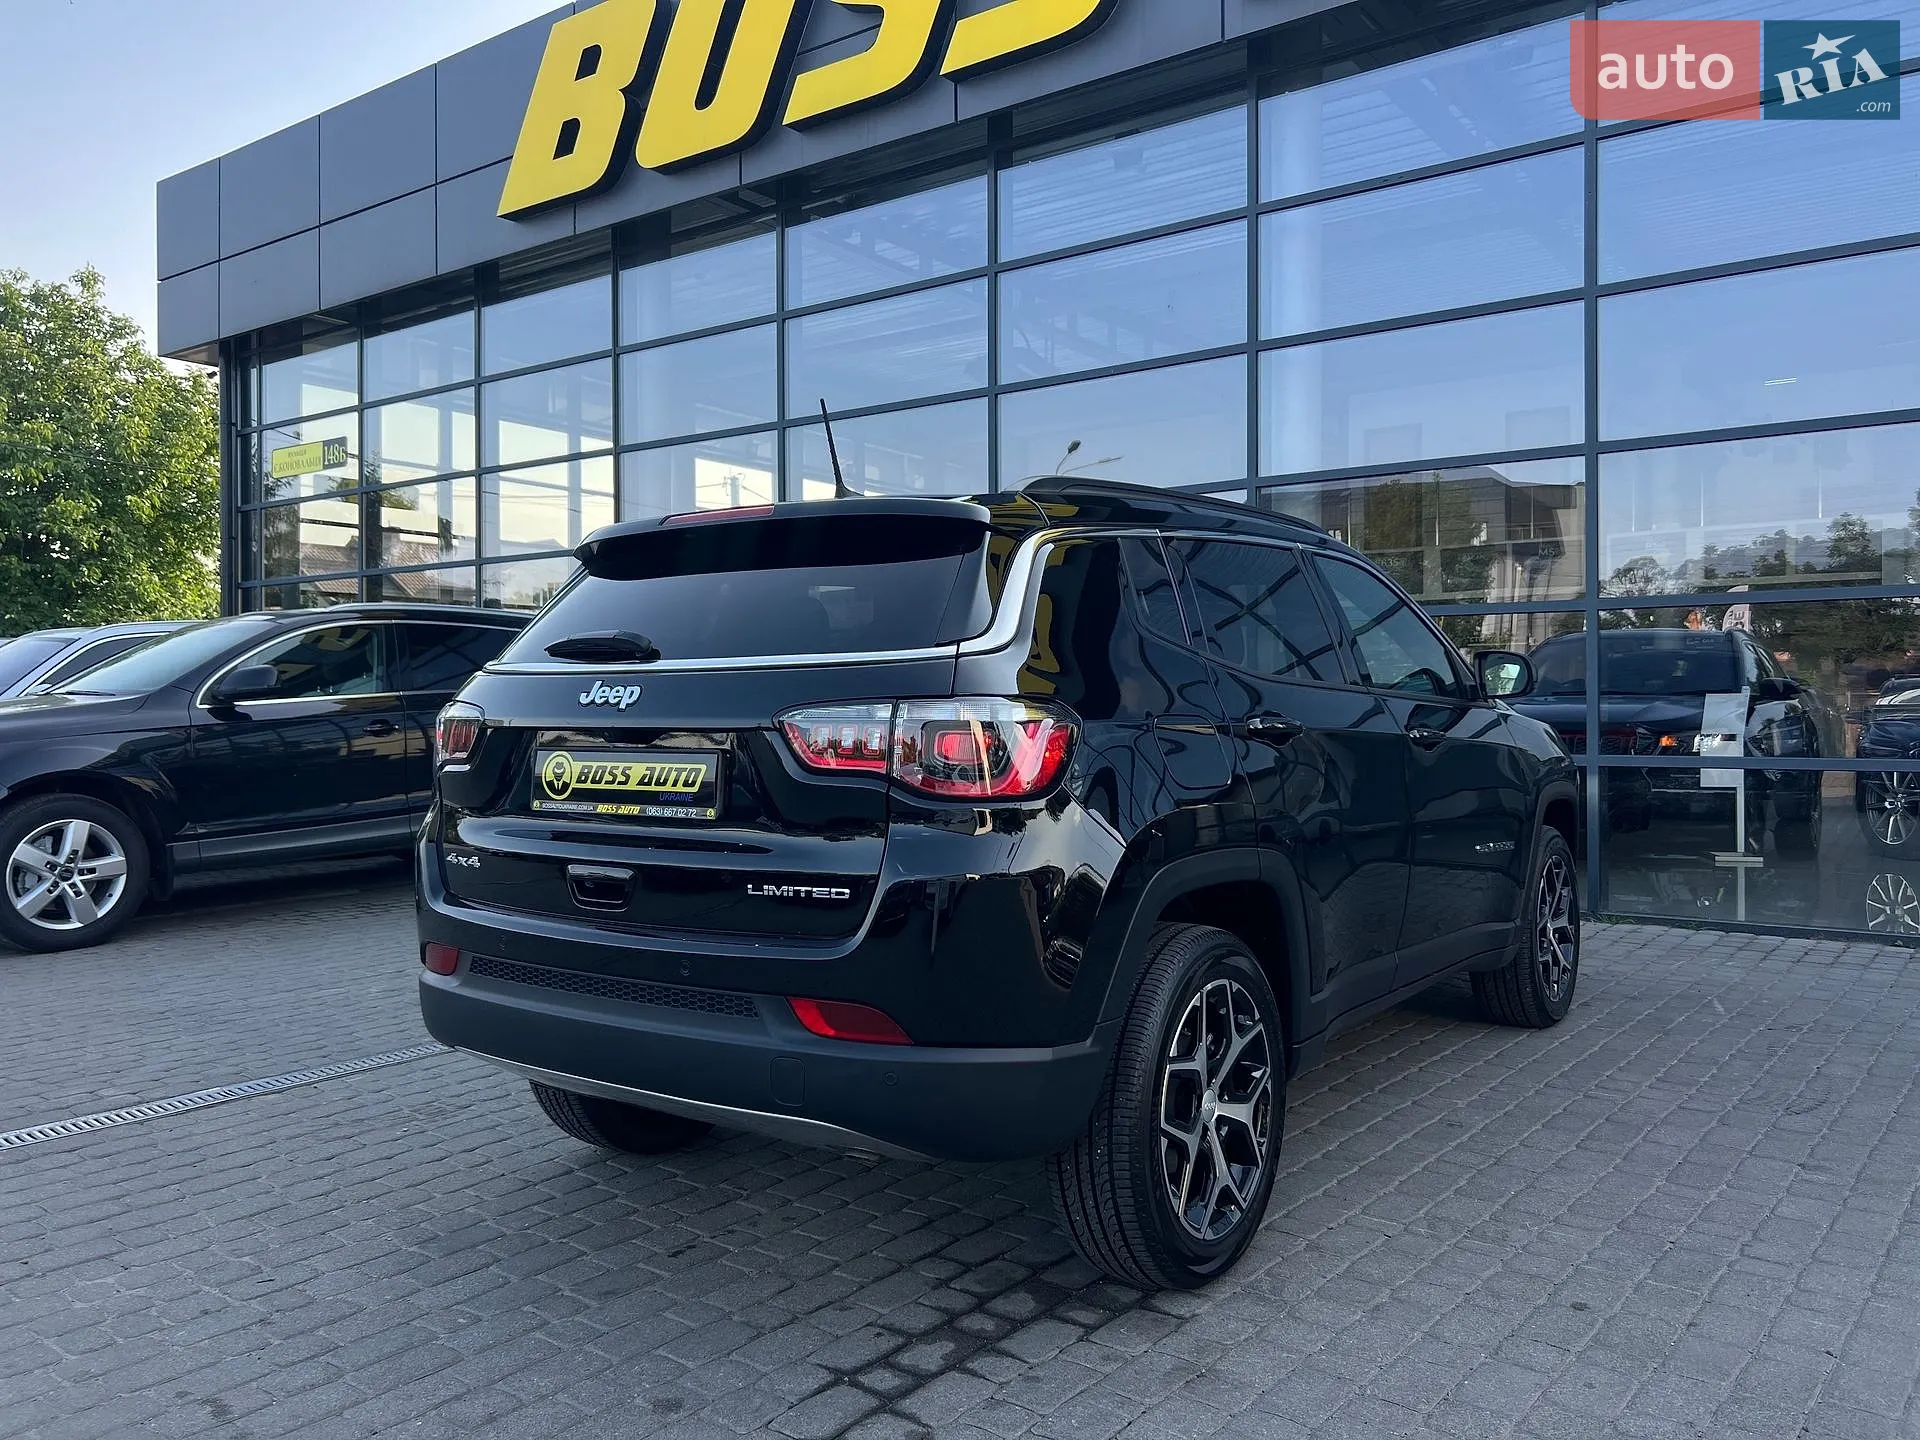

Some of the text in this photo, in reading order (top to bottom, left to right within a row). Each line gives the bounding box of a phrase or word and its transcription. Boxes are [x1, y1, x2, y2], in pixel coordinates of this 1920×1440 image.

[579, 680, 642, 711] Jeep
[576, 765, 702, 788] BOSS AUTO
[660, 792, 694, 802] UKRAINE
[596, 804, 617, 813] BOSS
[618, 805, 641, 815] AUTO
[664, 807, 677, 817] 667
[678, 808, 687, 817] 02
[687, 808, 697, 818] 72
[446, 852, 481, 868] 4x4
[747, 884, 850, 899] LIMITED
